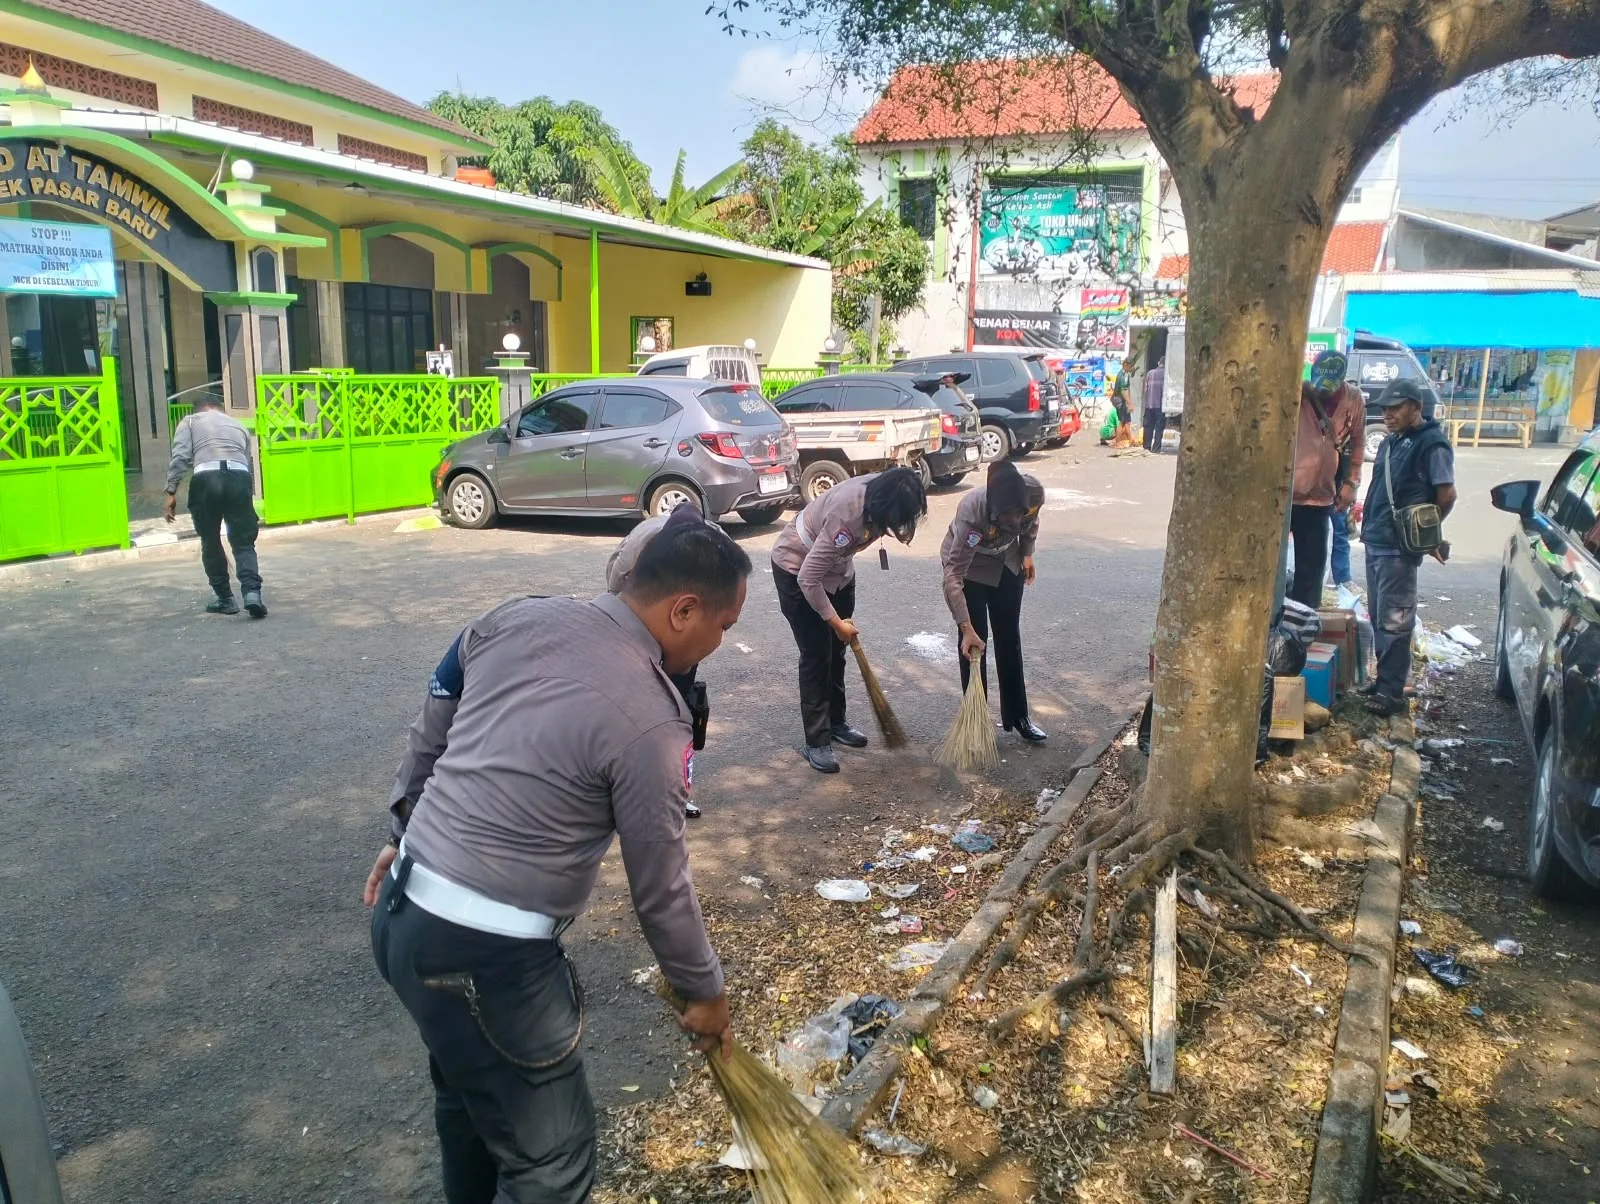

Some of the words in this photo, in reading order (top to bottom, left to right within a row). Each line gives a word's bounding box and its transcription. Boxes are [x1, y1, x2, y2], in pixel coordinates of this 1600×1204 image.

[27, 146, 63, 173] AT
[71, 155, 172, 231] TAMWIL
[31, 177, 100, 208] PASAR
[105, 199, 157, 239] BARU
[1039, 215, 1066, 227] TOKO
[31, 227, 59, 240] STOP
[0, 242, 44, 255] MATIKAN
[46, 246, 78, 257] ROKOK
[79, 249, 103, 259] ANDA
[41, 261, 70, 271] DISINI
[33, 277, 42, 285] DI
[43, 277, 75, 287] SEBELAH
[76, 279, 100, 287] TIMUR
[1011, 319, 1051, 331] BENAR
